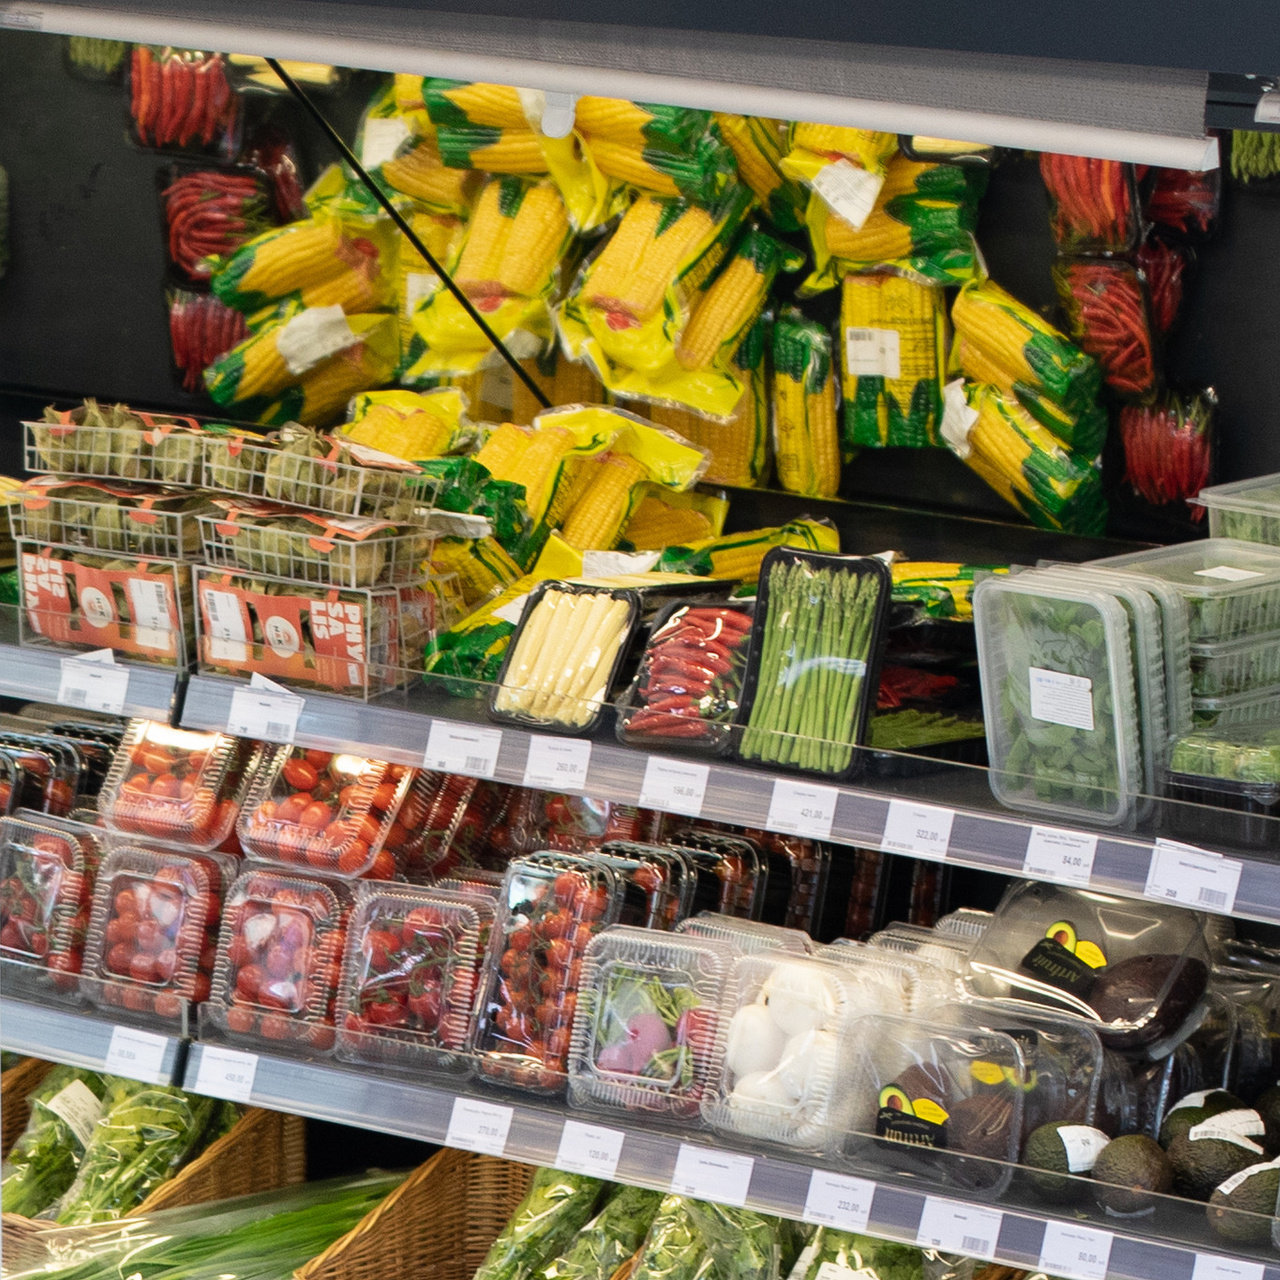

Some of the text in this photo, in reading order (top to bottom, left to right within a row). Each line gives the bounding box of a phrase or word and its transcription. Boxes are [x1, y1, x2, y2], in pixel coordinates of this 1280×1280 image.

[310, 600, 330, 640] LIS
[327, 602, 345, 637] SA
[344, 604, 365, 662] PHY
[916, 829, 939, 842] 522,00
[589, 1149, 609, 1161] 120,00
[837, 1200, 860, 1213] 232,00
